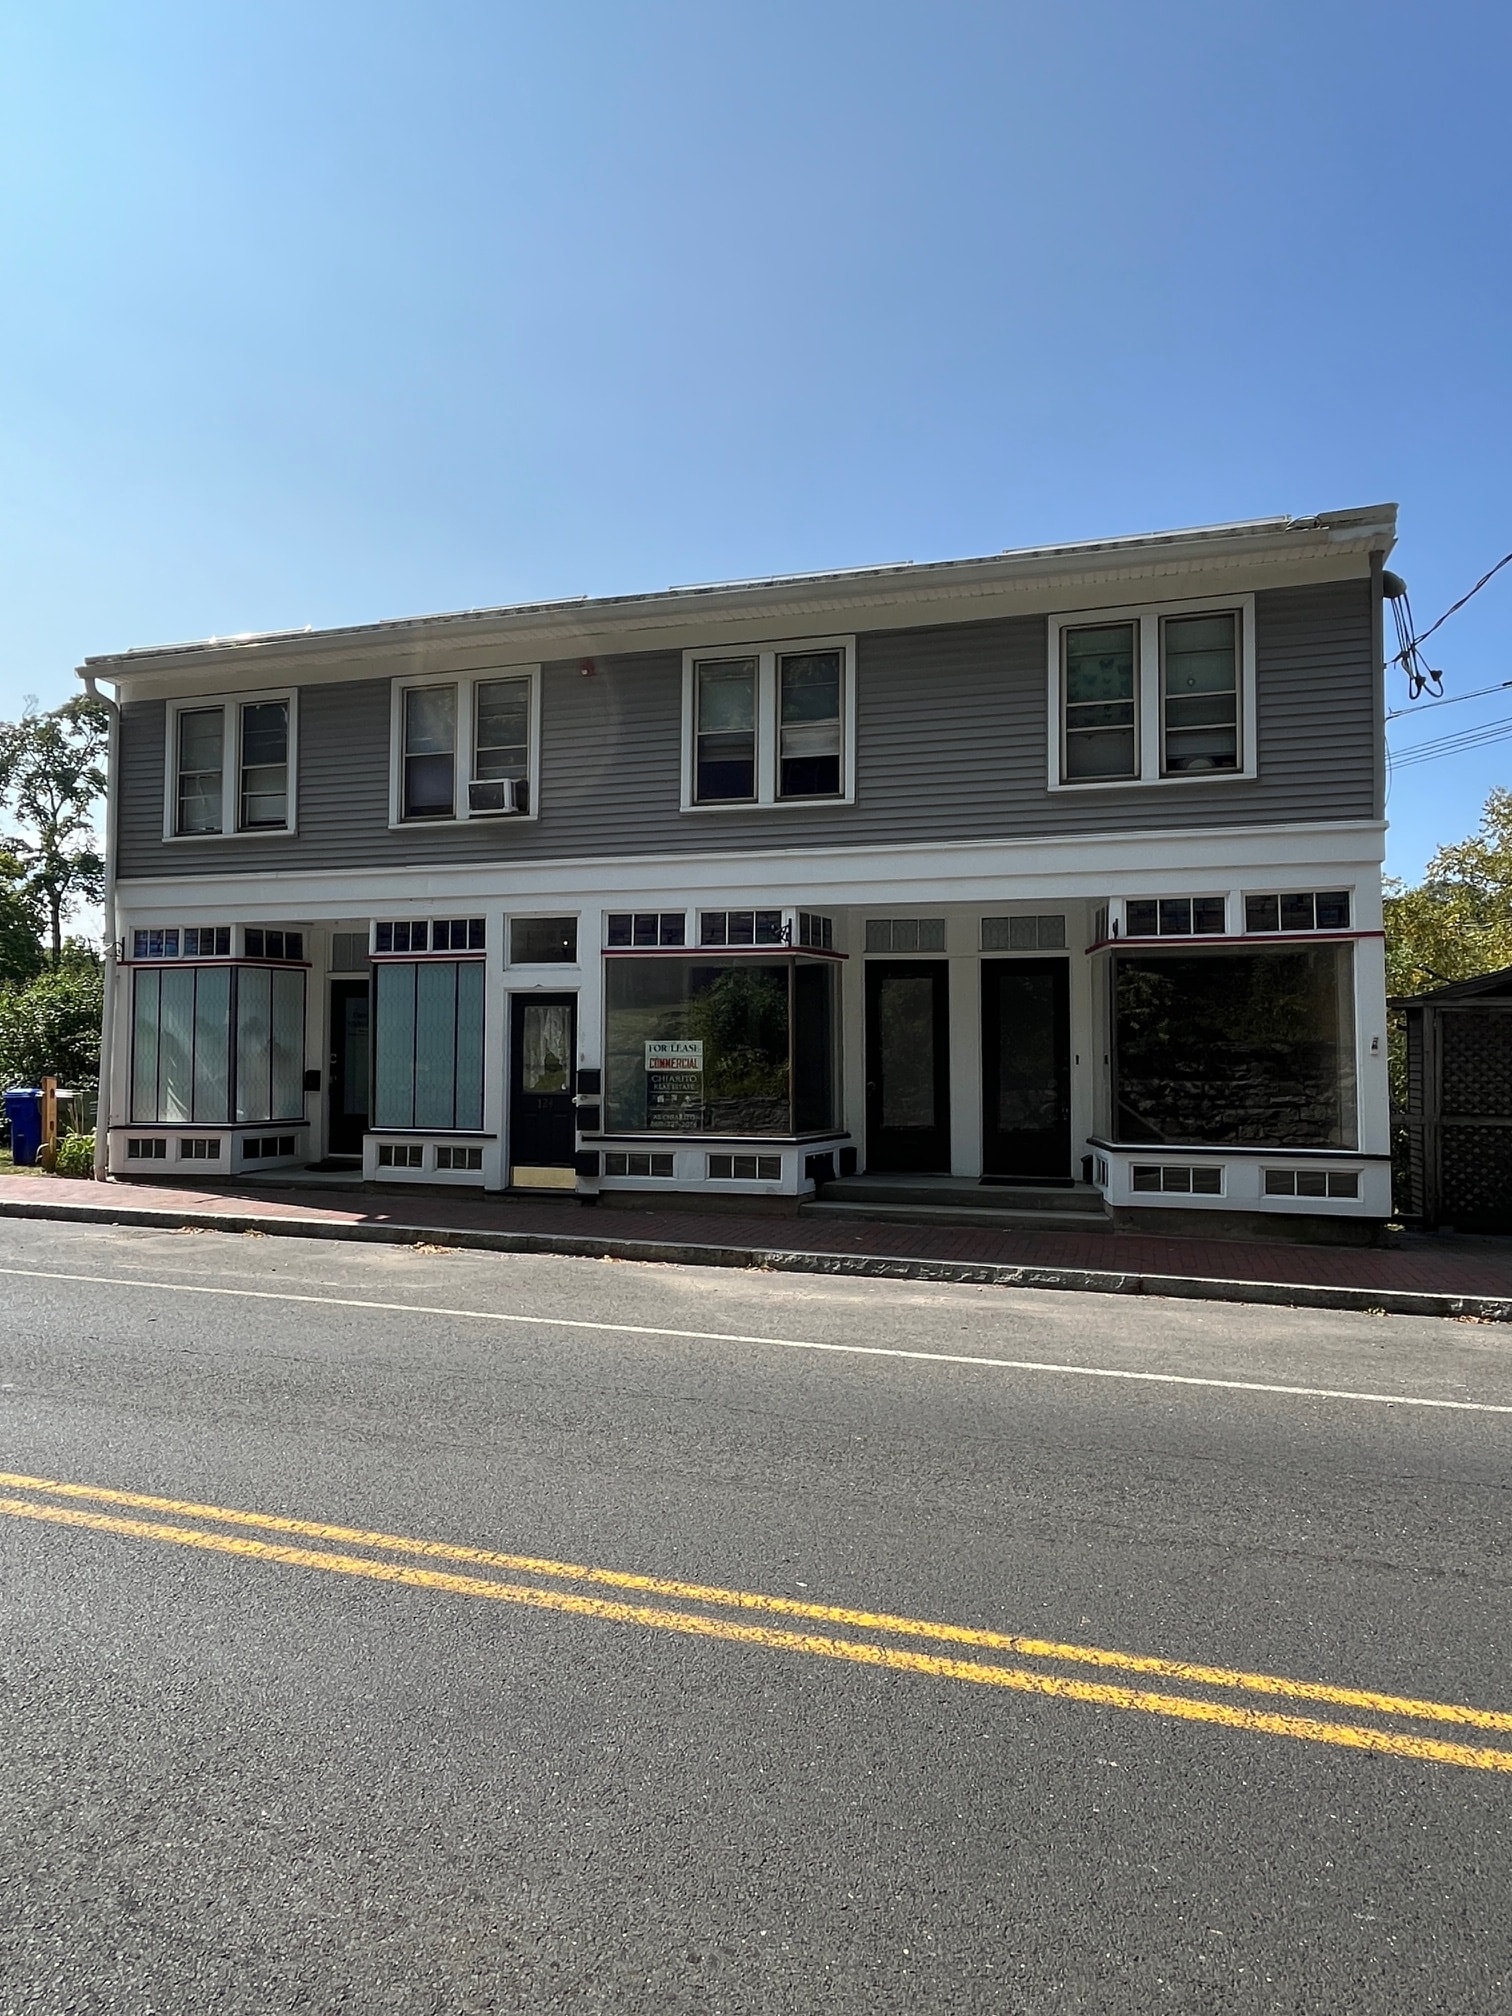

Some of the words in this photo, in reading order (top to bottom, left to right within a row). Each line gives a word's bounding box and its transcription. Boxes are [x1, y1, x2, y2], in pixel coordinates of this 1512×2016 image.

[649, 1044, 667, 1052] FOR
[670, 1044, 699, 1053] LEASE
[649, 1057, 699, 1069] COMMERCIAL
